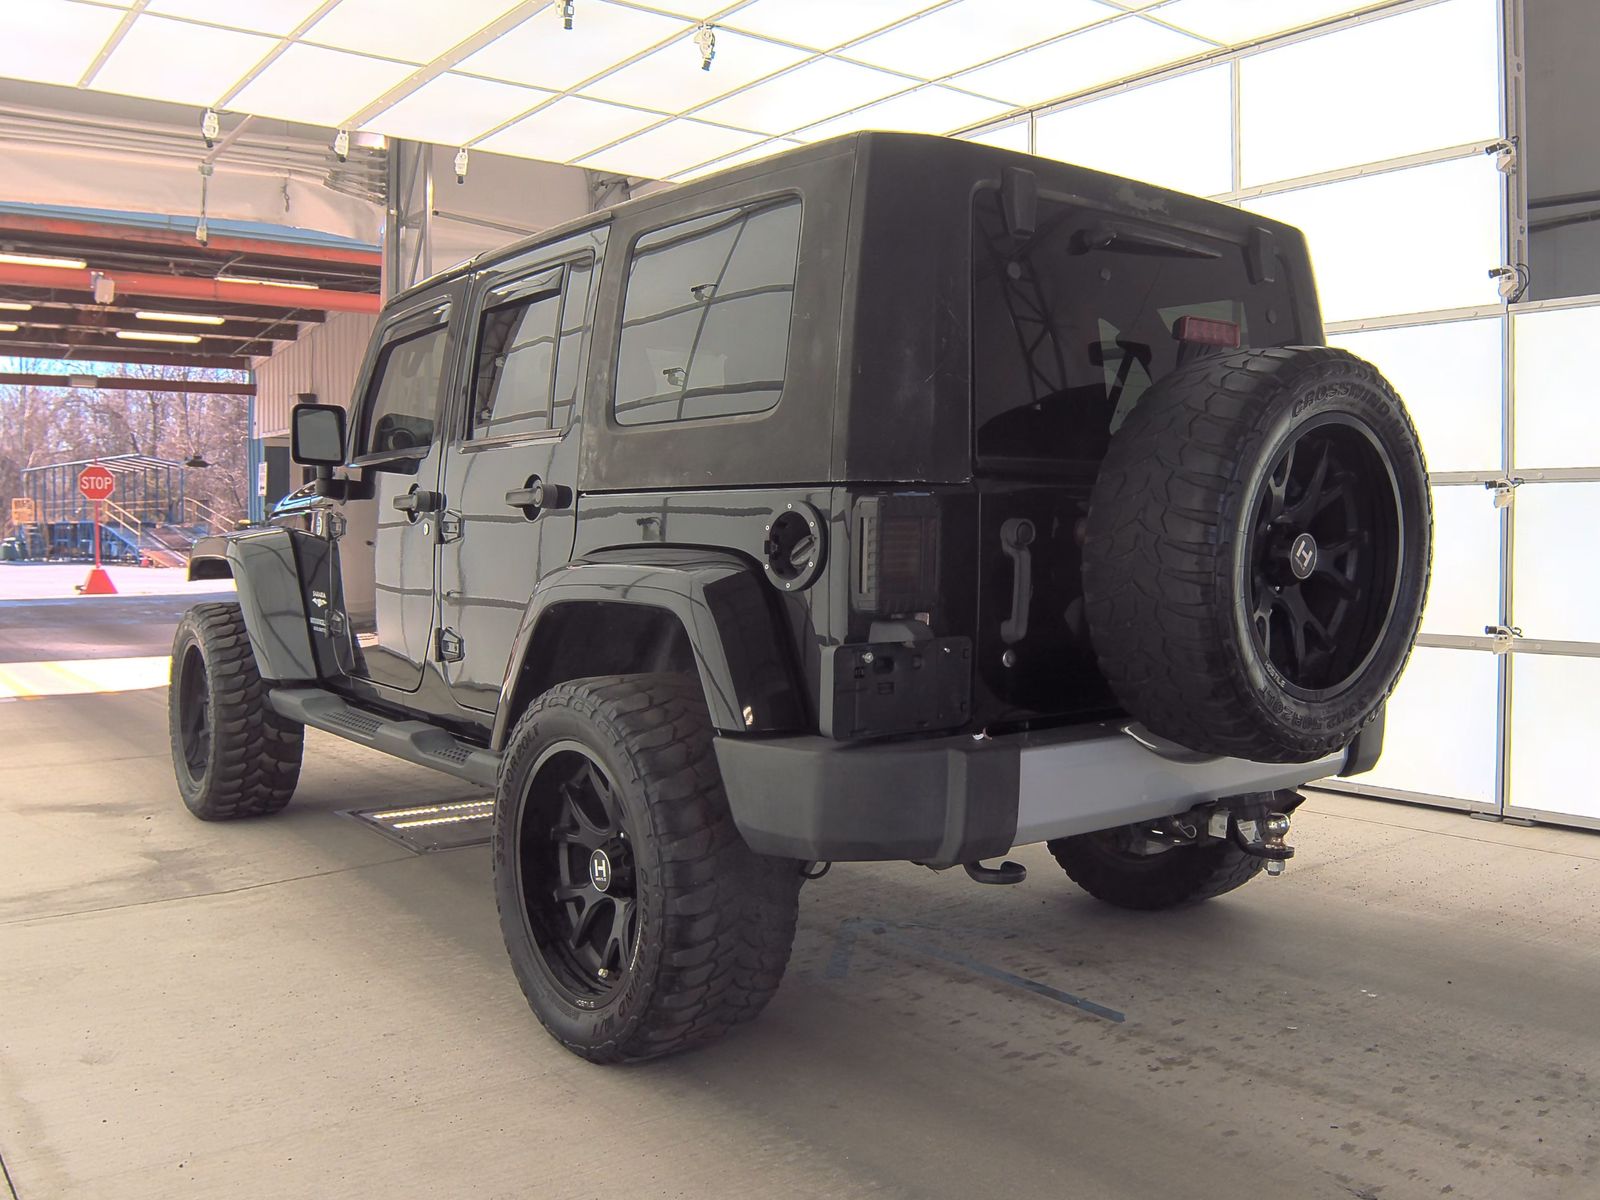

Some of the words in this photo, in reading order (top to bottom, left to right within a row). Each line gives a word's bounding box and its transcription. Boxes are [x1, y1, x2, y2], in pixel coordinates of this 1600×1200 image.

[1292, 382, 1391, 417] CROSSWIND
[81, 476, 112, 490] STOP
[1264, 660, 1287, 688] HOSTILE
[594, 859, 607, 878] H
